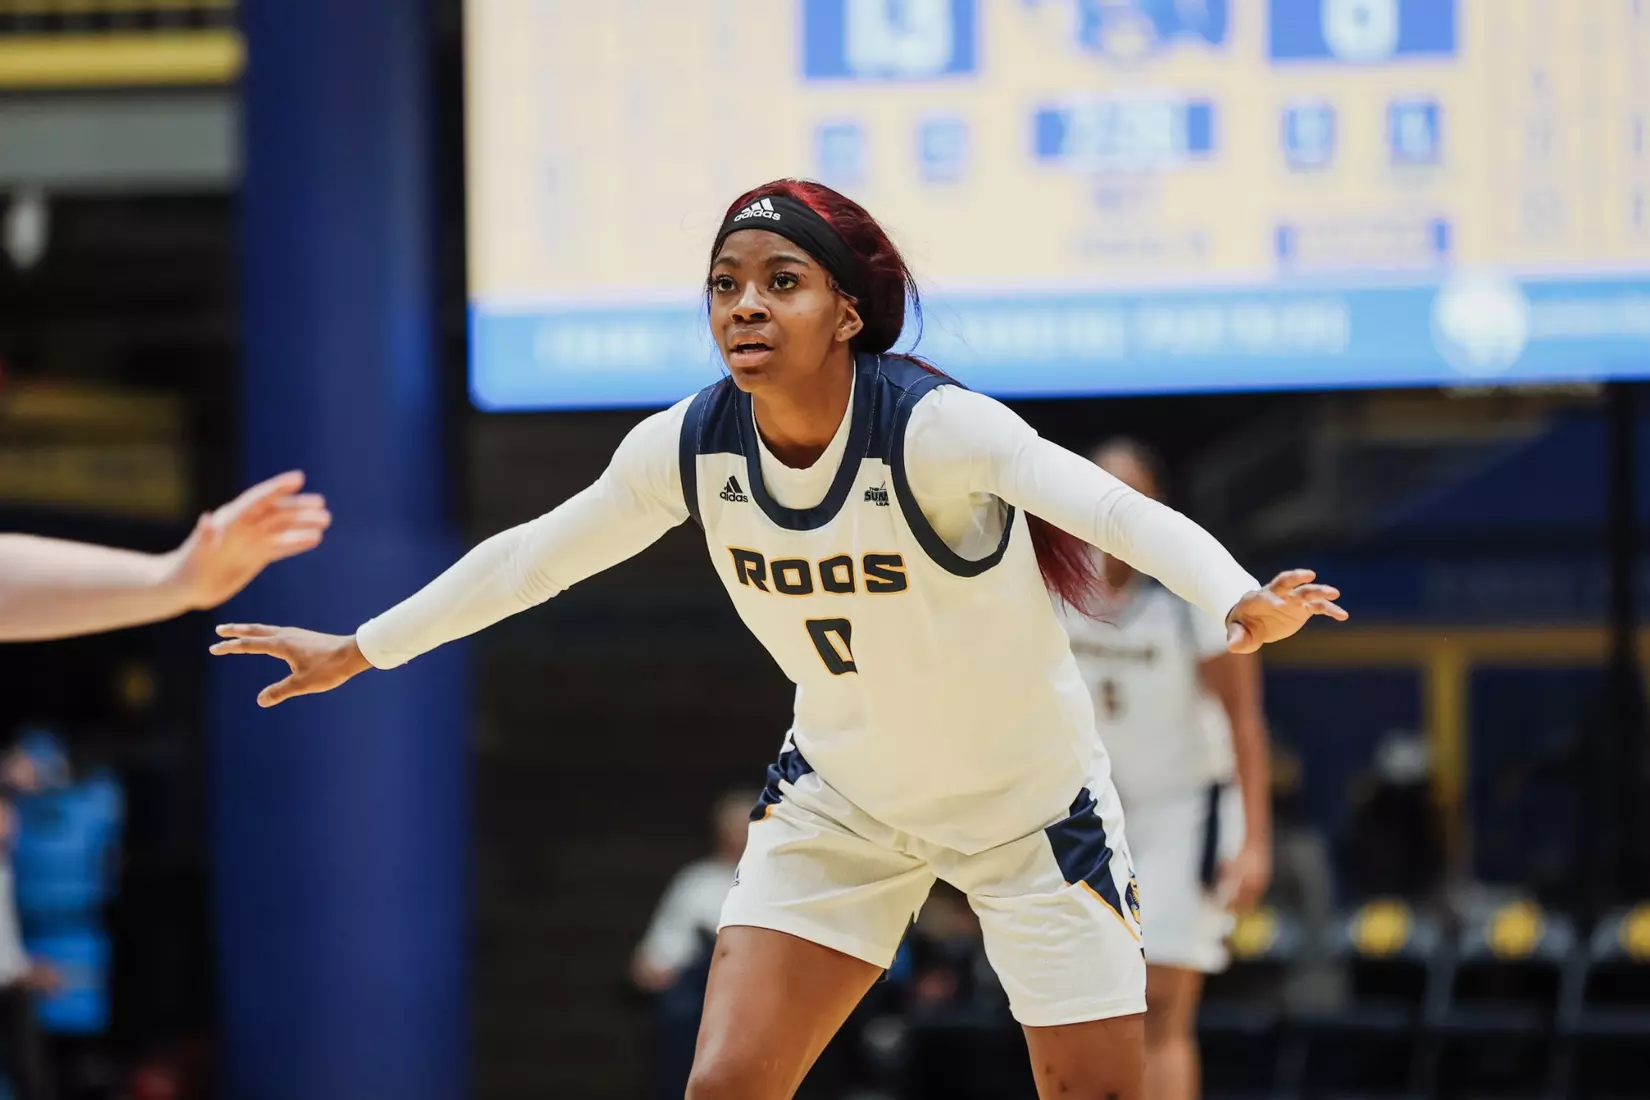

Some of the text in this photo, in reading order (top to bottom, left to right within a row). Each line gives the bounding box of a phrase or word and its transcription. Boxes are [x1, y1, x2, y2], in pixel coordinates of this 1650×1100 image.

[734, 208, 781, 222] adidas
[727, 546, 910, 596] ROOS
[804, 617, 858, 675] 0
